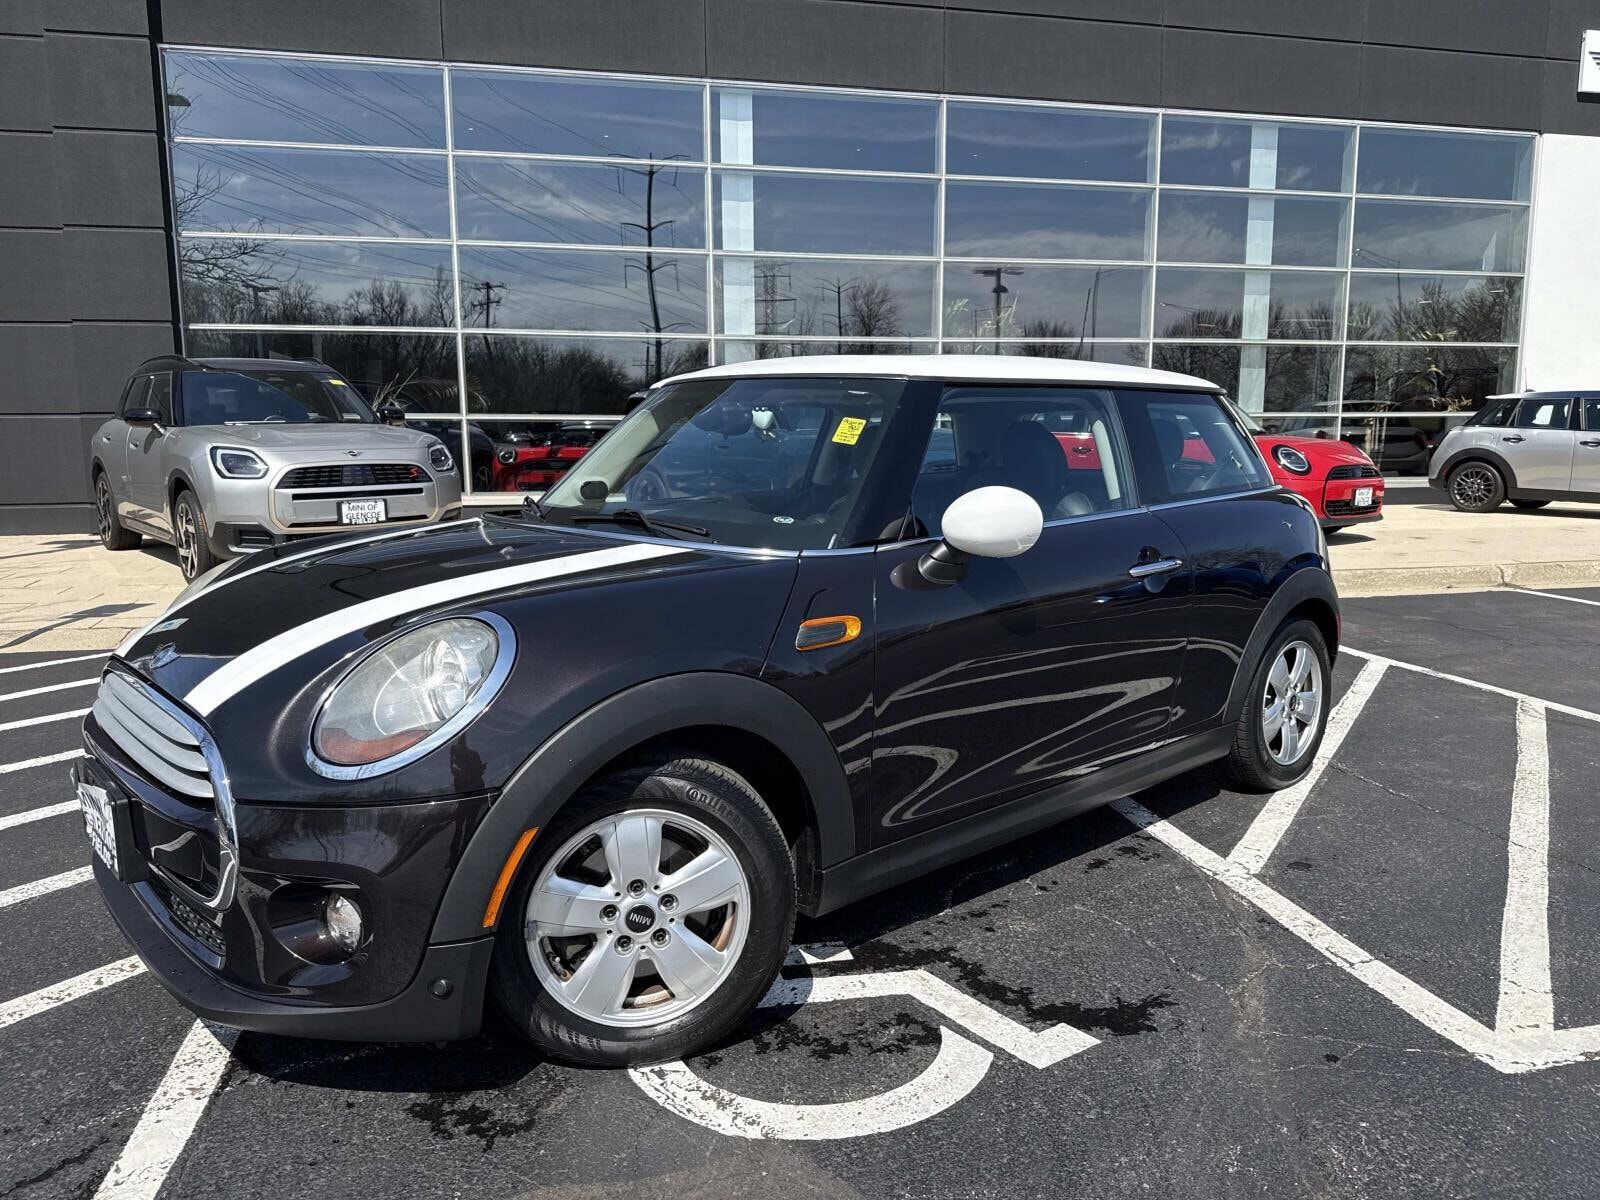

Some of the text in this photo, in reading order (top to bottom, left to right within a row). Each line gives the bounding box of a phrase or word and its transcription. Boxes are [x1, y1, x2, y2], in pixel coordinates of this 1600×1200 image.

[347, 503, 379, 512] MINI OF
[345, 511, 381, 520] GLENCOE
[629, 912, 652, 926] MINI
